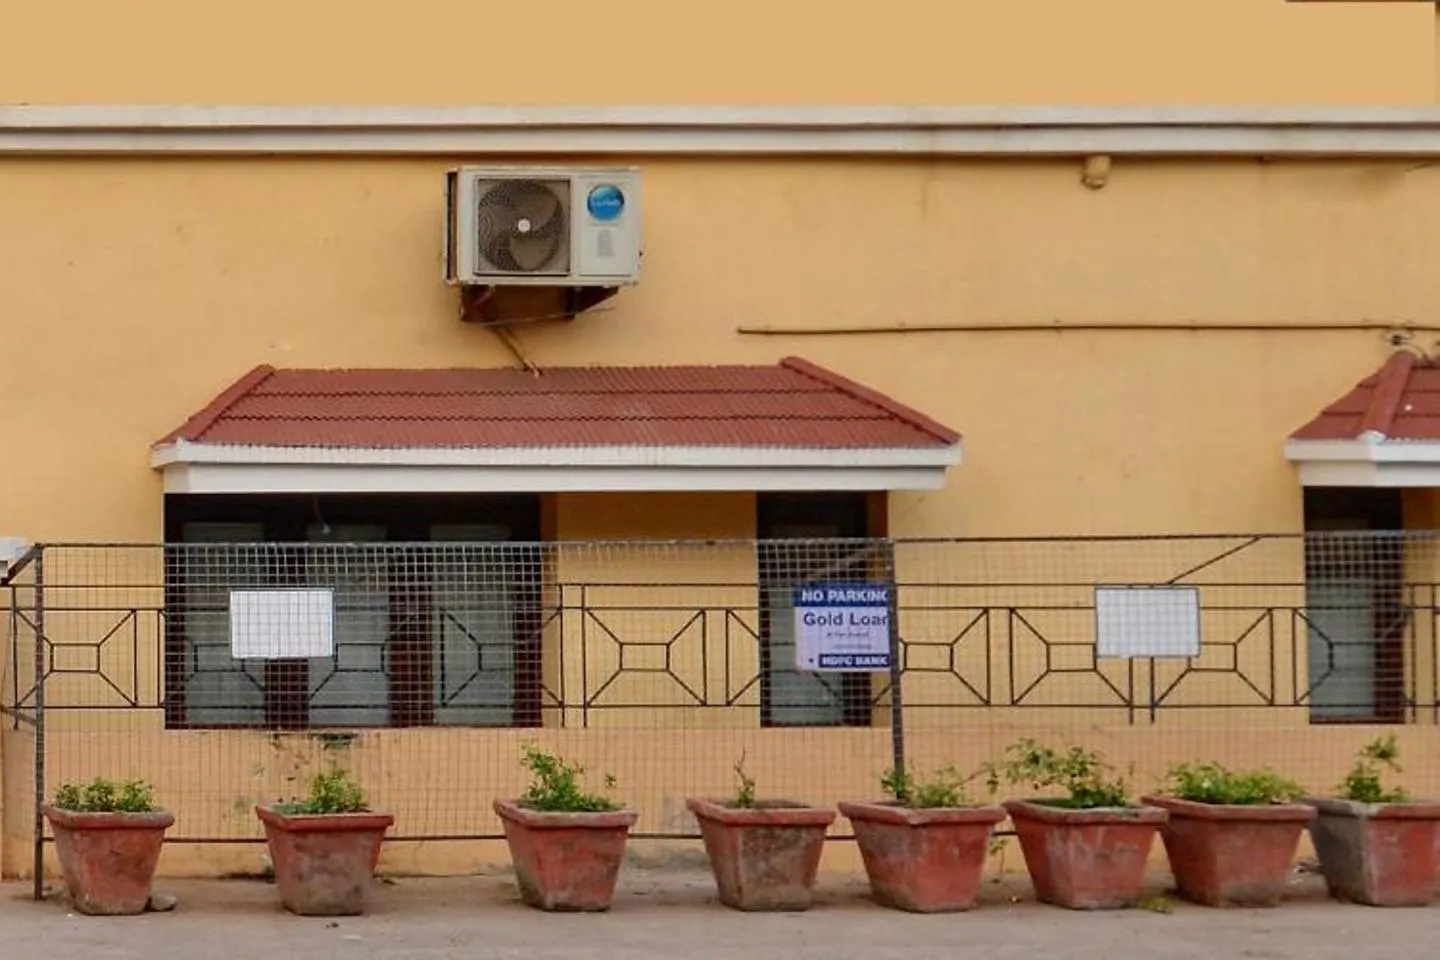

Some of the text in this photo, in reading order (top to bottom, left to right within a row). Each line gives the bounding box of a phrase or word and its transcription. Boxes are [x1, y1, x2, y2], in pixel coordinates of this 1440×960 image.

[802, 589, 823, 602] NO
[803, 611, 843, 627] Gold
[855, 656, 888, 665] BANK
